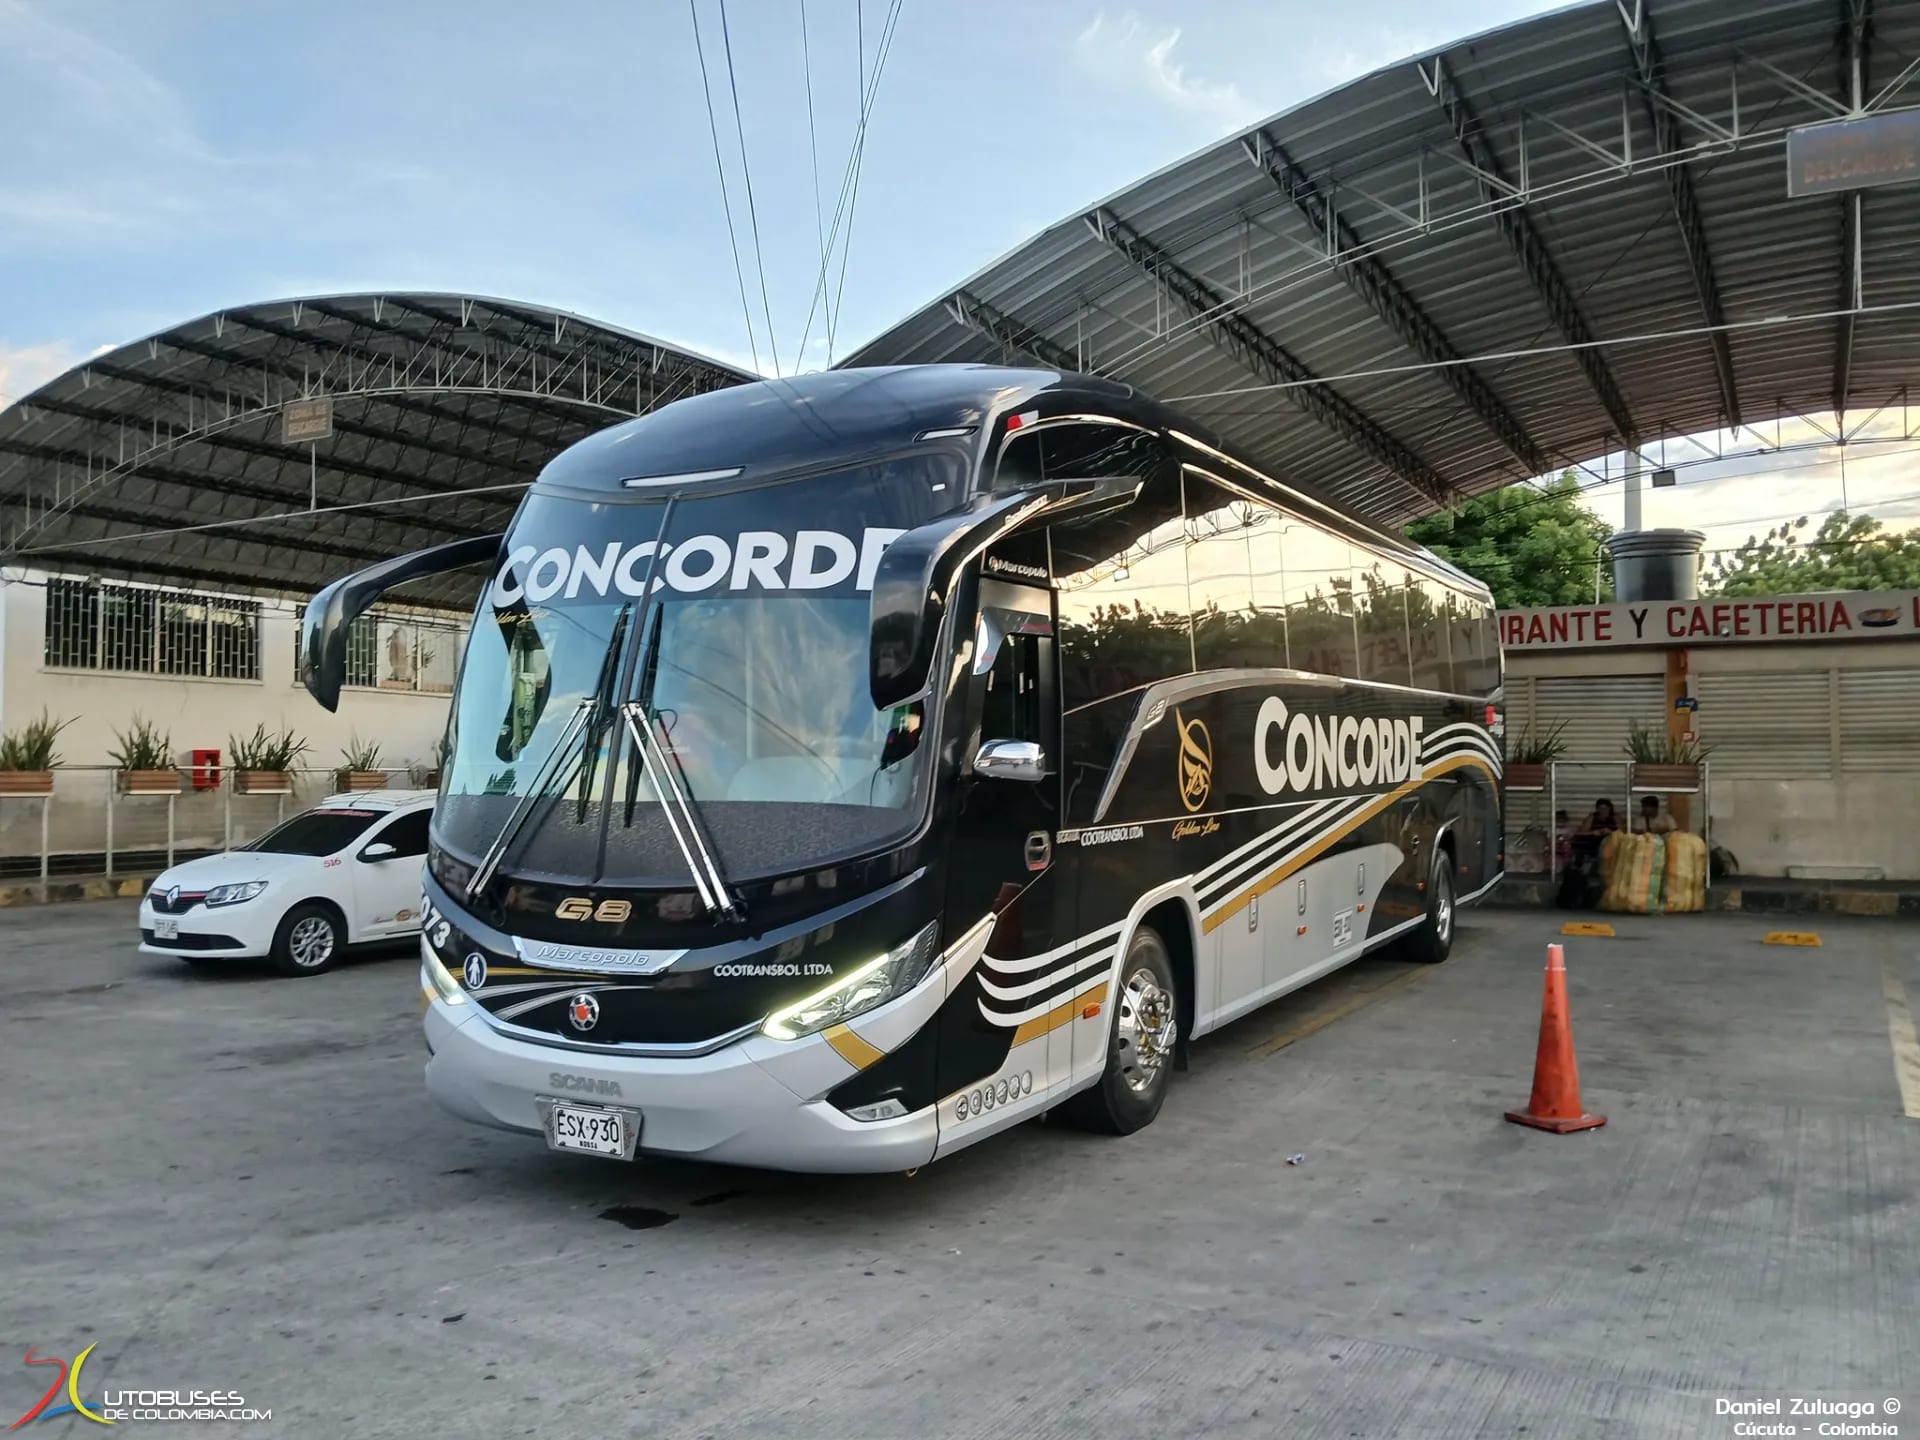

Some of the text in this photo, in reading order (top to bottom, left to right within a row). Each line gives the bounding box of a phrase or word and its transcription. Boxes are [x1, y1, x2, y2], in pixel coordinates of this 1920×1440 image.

[1500, 610, 1612, 645] RANTE
[1629, 608, 1648, 639] Y
[1666, 600, 1853, 638] CAFETERIA
[1254, 696, 1424, 795] CONCORDE
[1172, 820, 1200, 841] Golden
[555, 897, 633, 922] G8
[537, 944, 650, 966] Marcopolo
[713, 963, 834, 977] COOTRANSBOL LTDA
[549, 1072, 624, 1098] SCANIA
